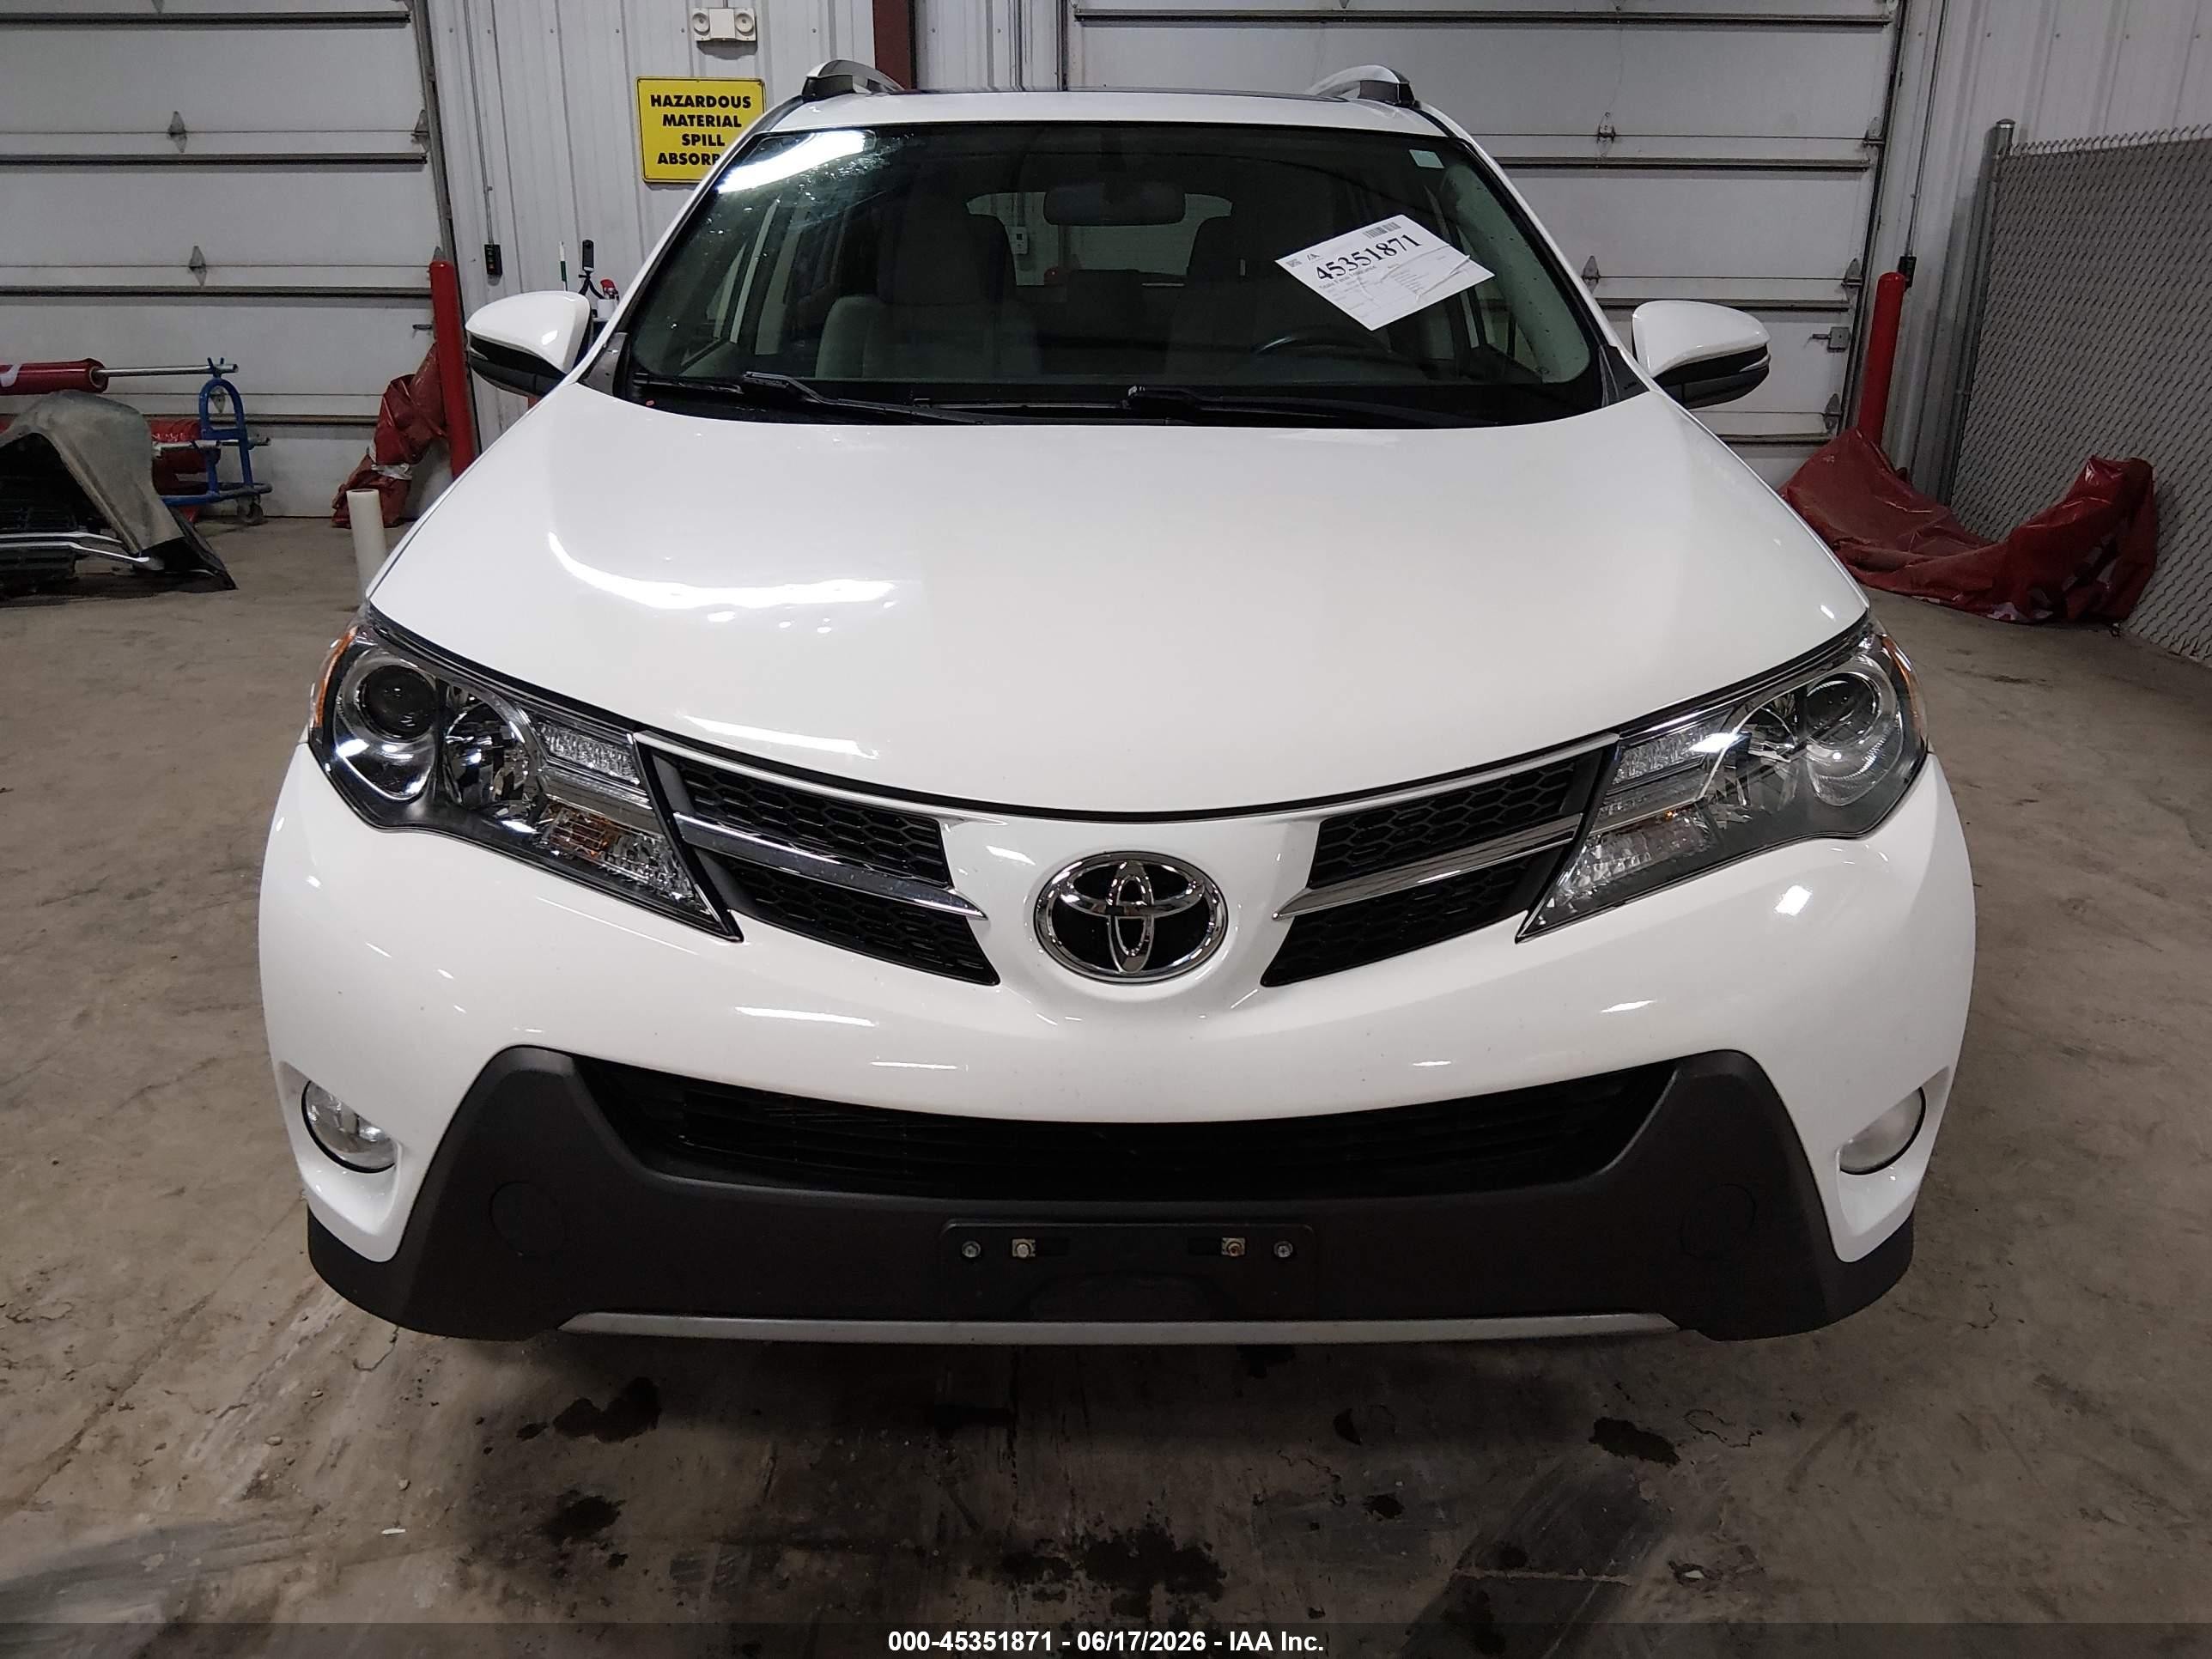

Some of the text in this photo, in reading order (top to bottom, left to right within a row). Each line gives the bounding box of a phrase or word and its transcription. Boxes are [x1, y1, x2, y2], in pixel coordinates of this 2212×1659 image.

[650, 94, 751, 109] HAZARDOUS
[662, 113, 742, 128] MATERIAL
[682, 133, 726, 147] SPILL
[1316, 234, 1422, 280] 45351871
